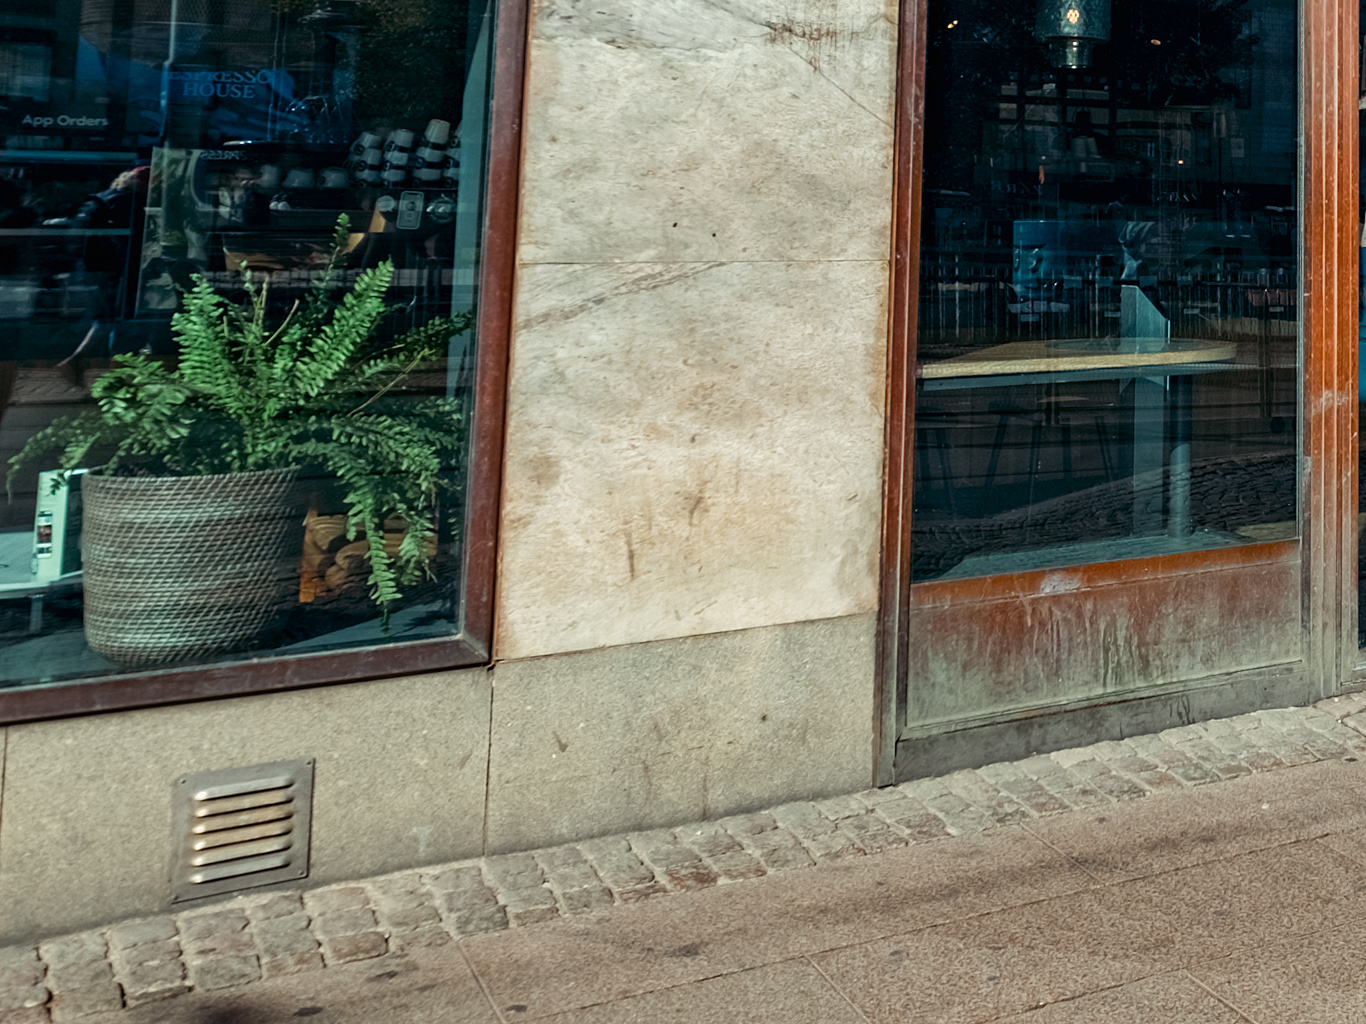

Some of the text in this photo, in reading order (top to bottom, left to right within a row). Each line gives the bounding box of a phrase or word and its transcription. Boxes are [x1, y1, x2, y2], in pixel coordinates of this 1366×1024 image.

[183, 81, 256, 99] HOUSE
[22, 114, 109, 127] App Orders
